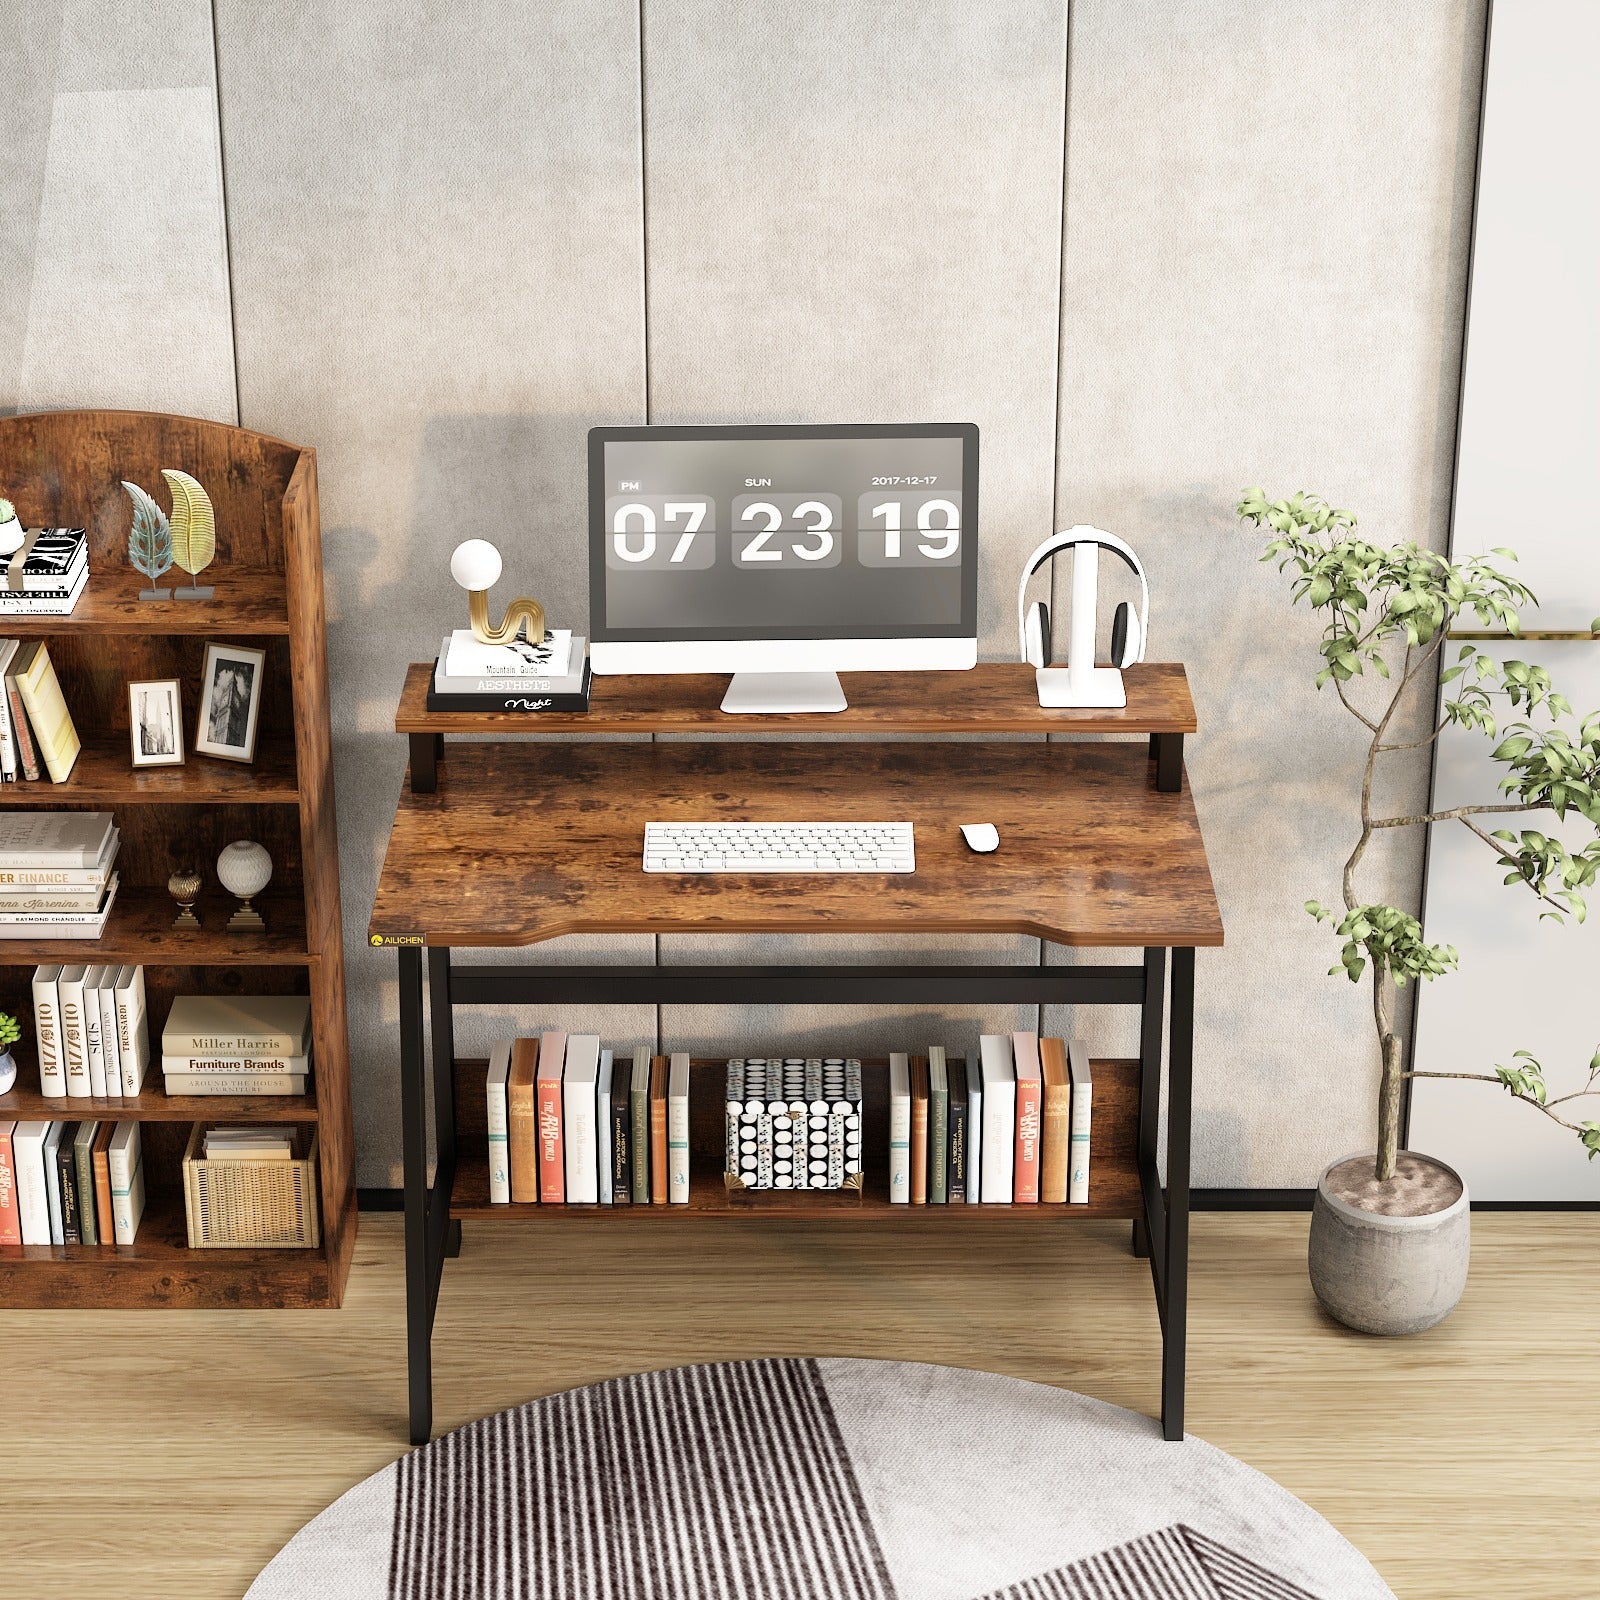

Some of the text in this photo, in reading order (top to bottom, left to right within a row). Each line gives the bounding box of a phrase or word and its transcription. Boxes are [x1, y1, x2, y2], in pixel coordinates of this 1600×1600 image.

[621, 482, 639, 490] PM
[744, 478, 771, 488] SUN
[872, 476, 938, 486] 2017-12-17
[613, 502, 707, 563] 07
[740, 500, 834, 562] 23
[872, 498, 960, 560] 19
[486, 665, 538, 674] Mountain Guide
[476, 680, 550, 690] AESTHETE
[504, 698, 552, 710] Night
[18, 874, 70, 883] FINANCE
[22, 899, 80, 909] Karenina
[118, 1004, 130, 1052] TRUSSARDI
[88, 1022, 101, 1054] SICIS
[192, 1038, 280, 1049] Miller Harris
[190, 1059, 285, 1068] Furniture Brands
[540, 1101, 558, 1162] THE ARAB WORLD
[1, 1188, 10, 1208] WORLD
